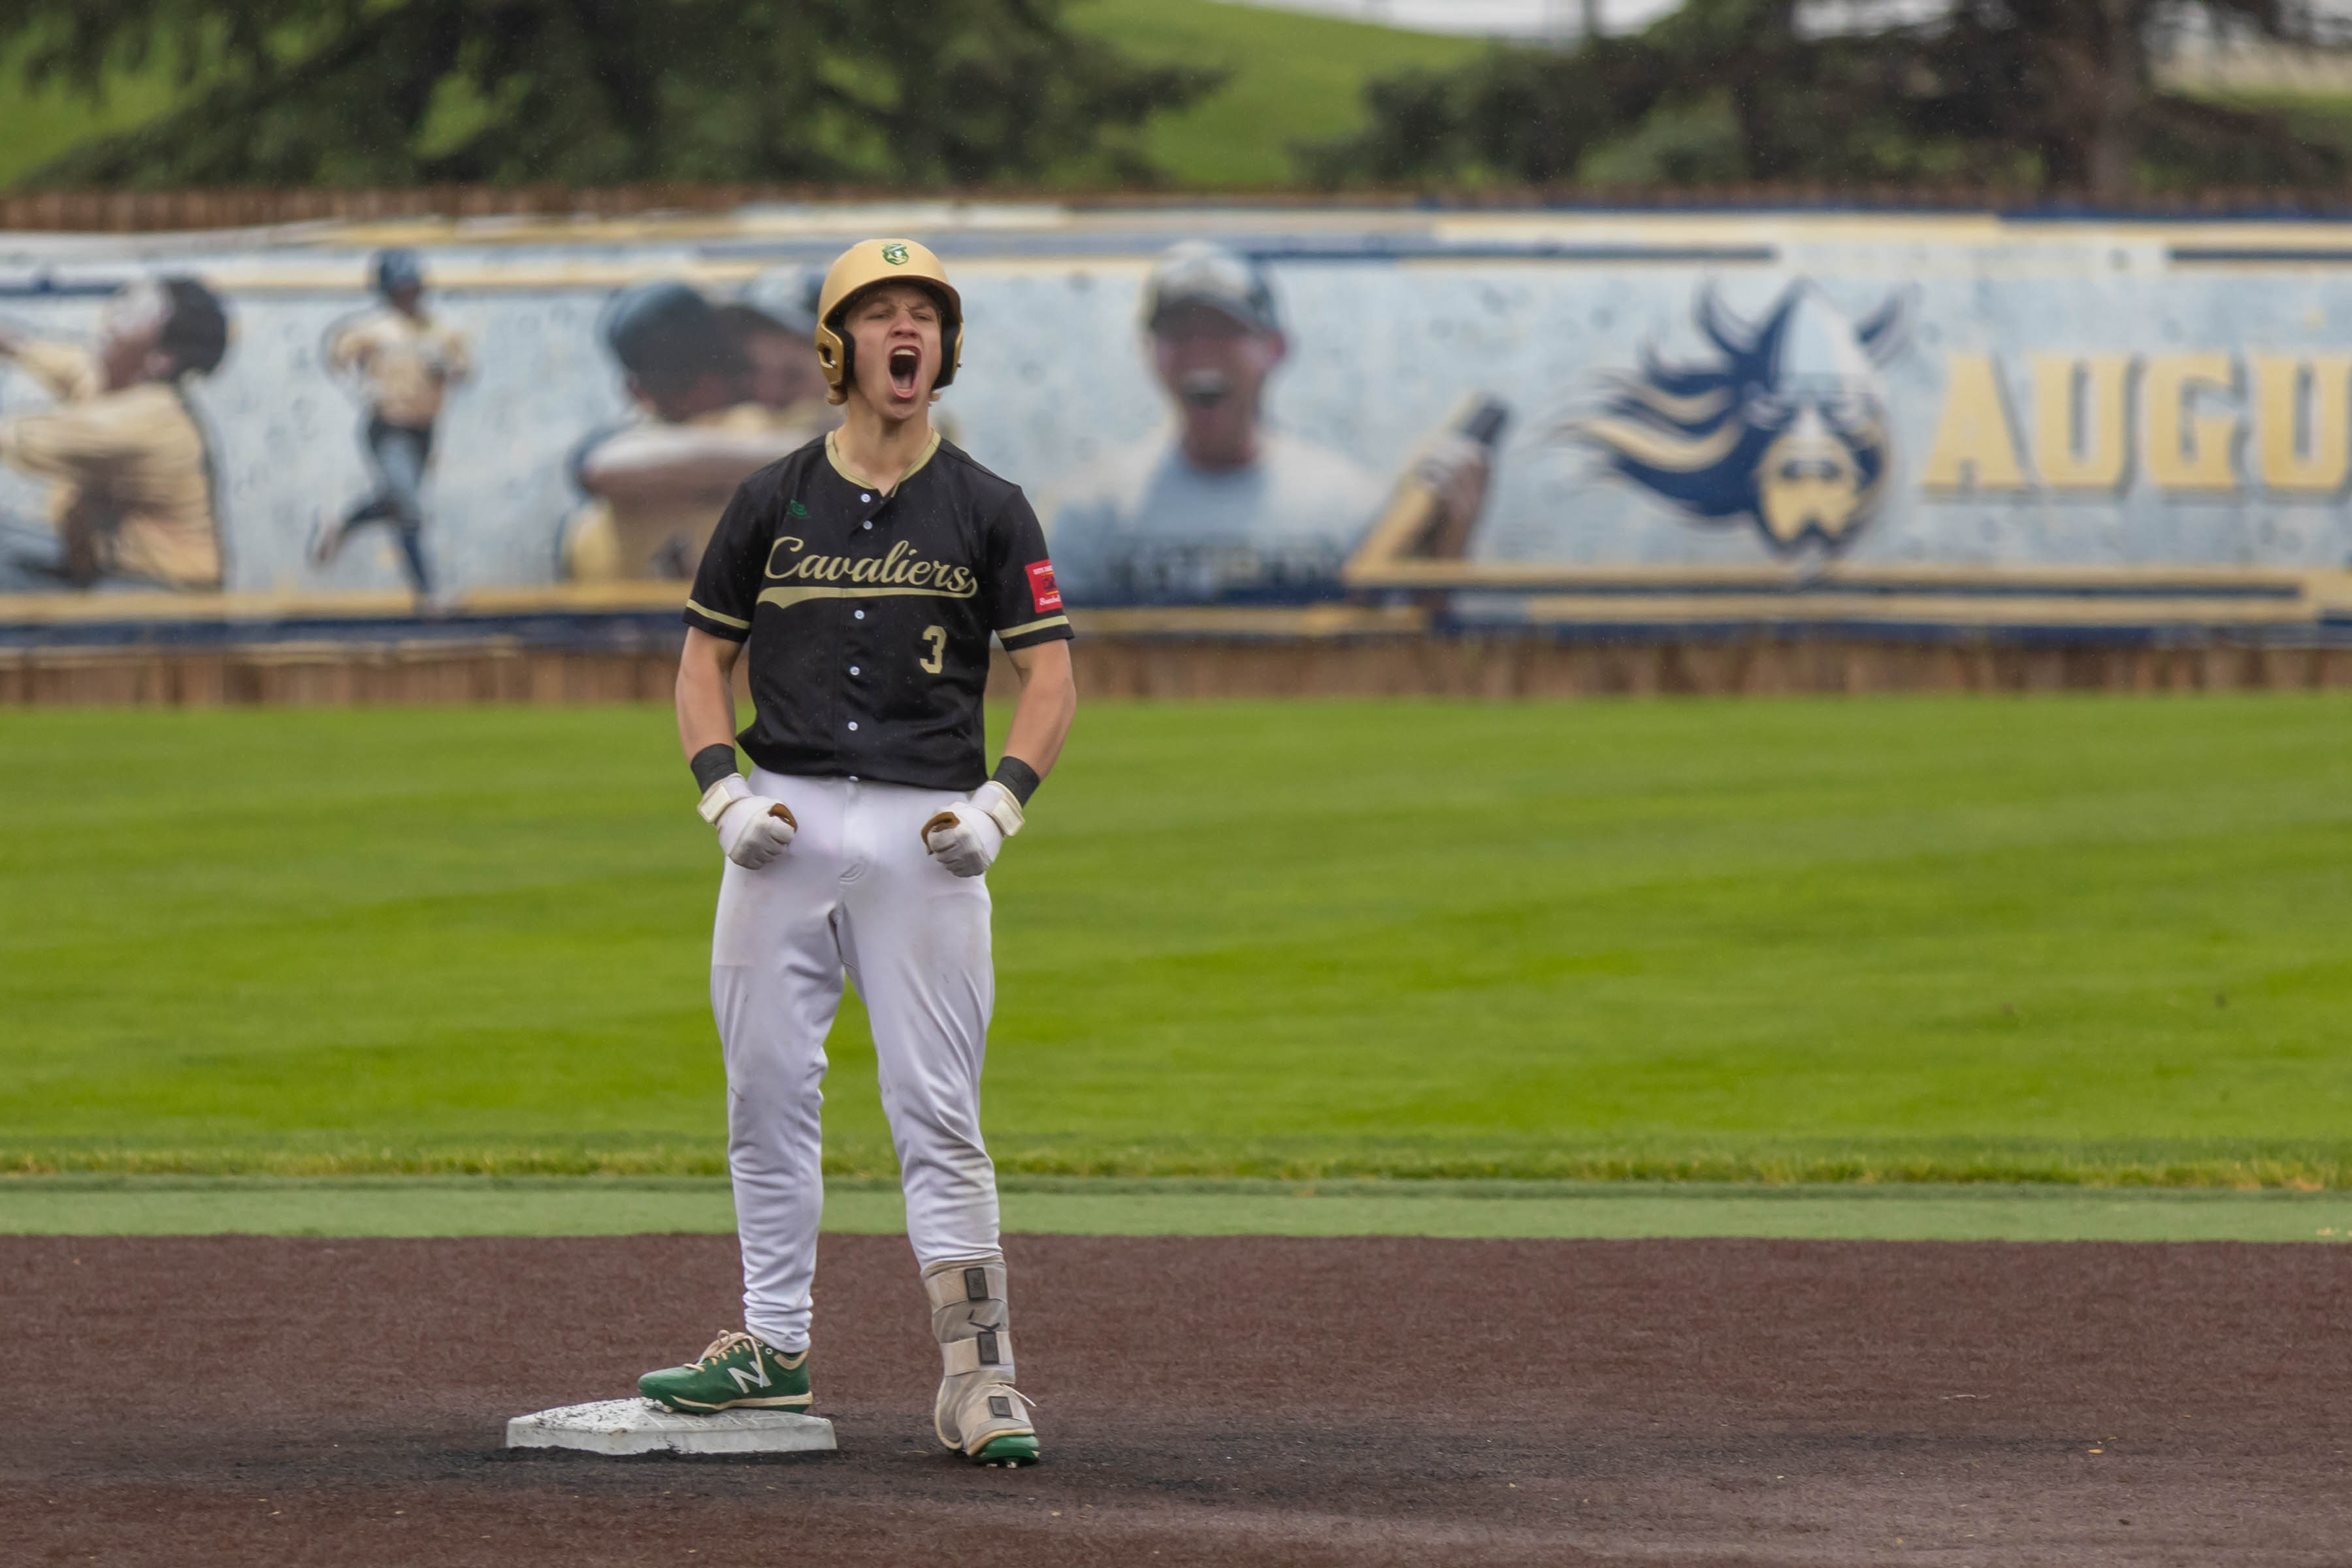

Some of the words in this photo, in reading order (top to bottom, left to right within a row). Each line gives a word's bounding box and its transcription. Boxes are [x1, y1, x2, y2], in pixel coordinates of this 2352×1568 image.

[764, 536, 977, 593] Cavaliers
[920, 625, 947, 674] 3
[727, 1361, 772, 1394] N
